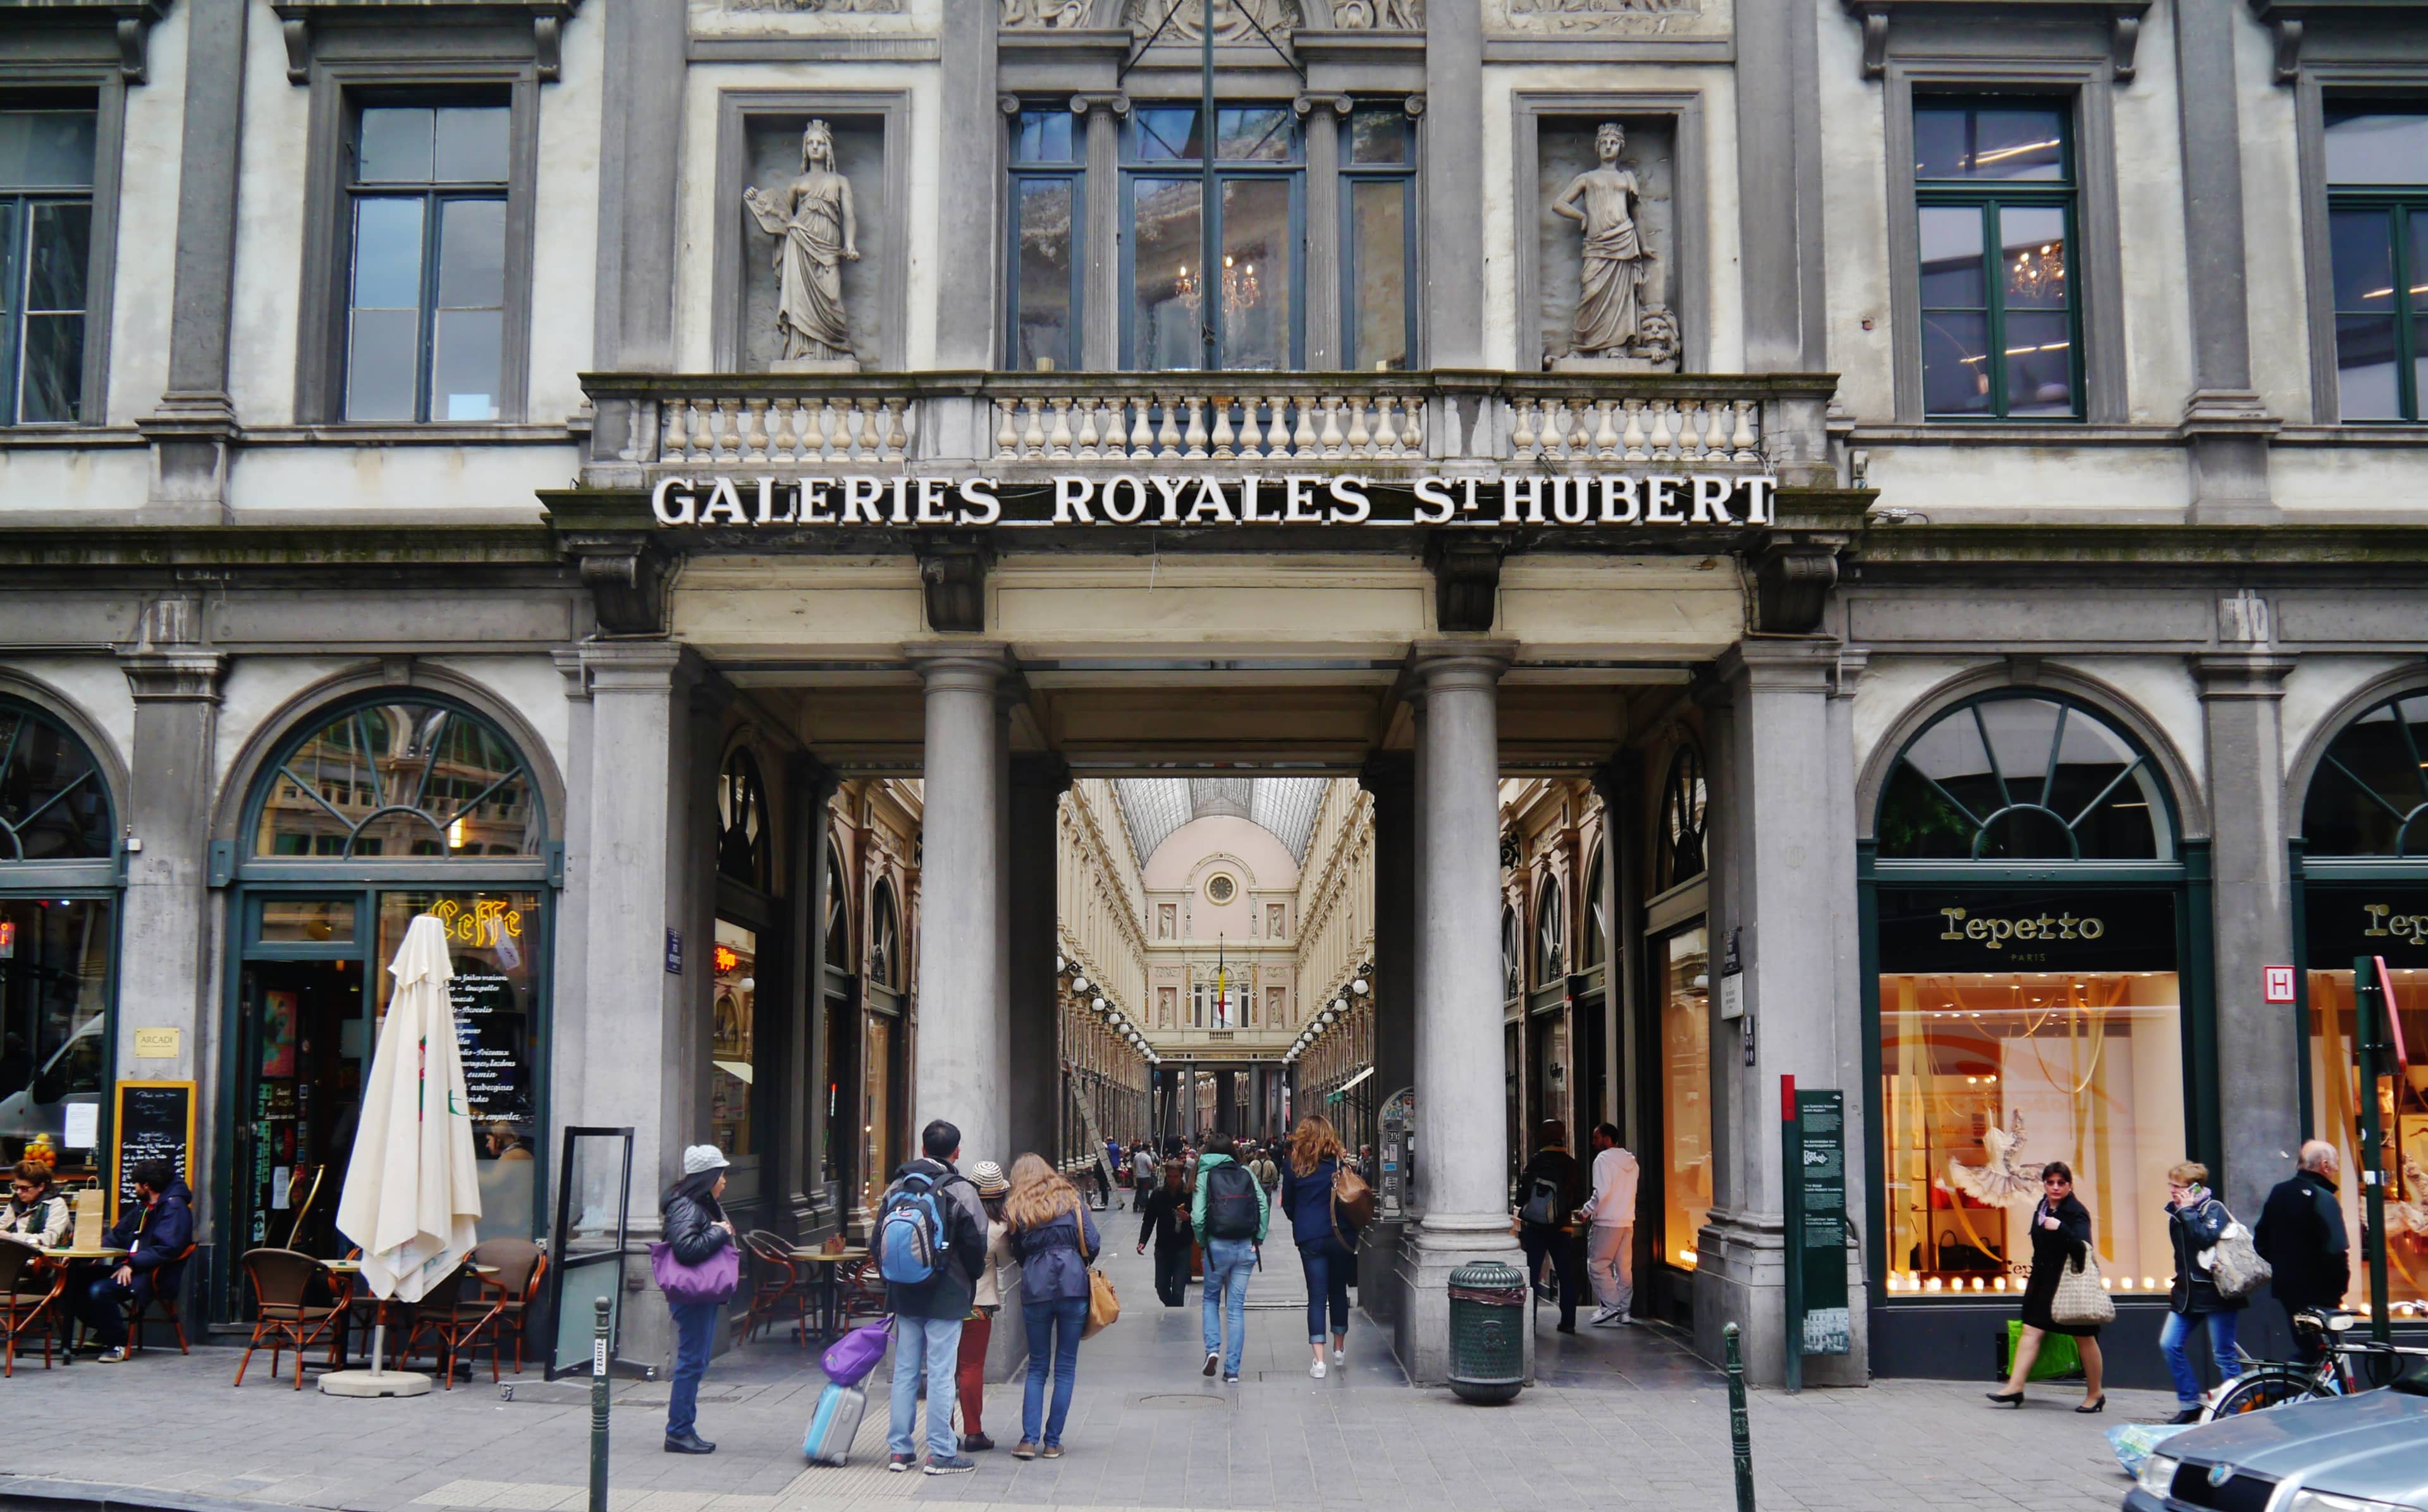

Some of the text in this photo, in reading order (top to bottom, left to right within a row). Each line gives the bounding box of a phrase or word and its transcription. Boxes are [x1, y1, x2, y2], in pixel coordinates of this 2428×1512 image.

[651, 475, 1002, 525] GALERIES
[1052, 475, 1371, 524] ROYALES
[1499, 475, 1777, 524] HUBERT
[1941, 907, 2104, 949] repetto
[2011, 953, 2046, 961] PARIS
[2272, 973, 2288, 996] H
